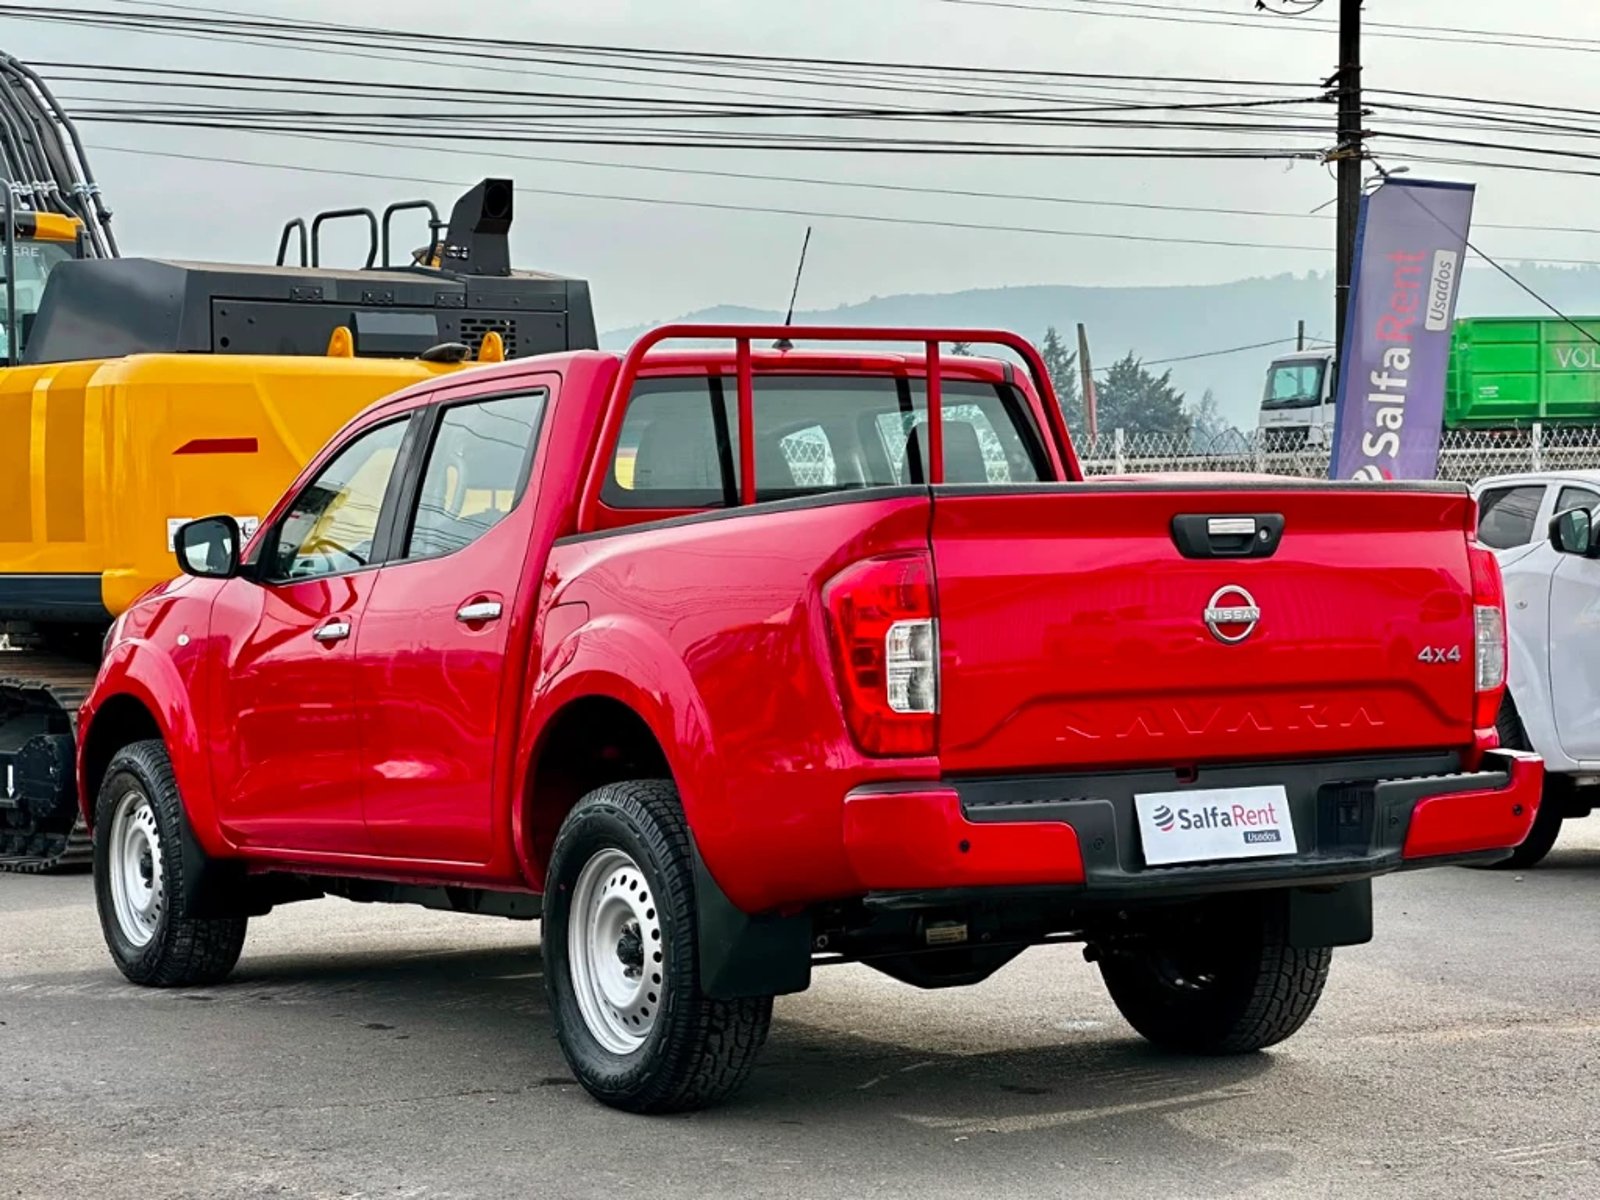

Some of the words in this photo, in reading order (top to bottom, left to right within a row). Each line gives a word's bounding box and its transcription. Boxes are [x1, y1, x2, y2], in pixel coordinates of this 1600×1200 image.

[1429, 260, 1452, 322] Usados
[1362, 248, 1427, 458] SalfaRent
[1556, 347, 1600, 368] VOL
[1206, 609, 1260, 620] NISSAN
[1417, 644, 1462, 662] 4x4
[1055, 700, 1385, 741] NAVARA
[1177, 802, 1279, 830] SalfaRent
[1246, 831, 1277, 843] Usados
